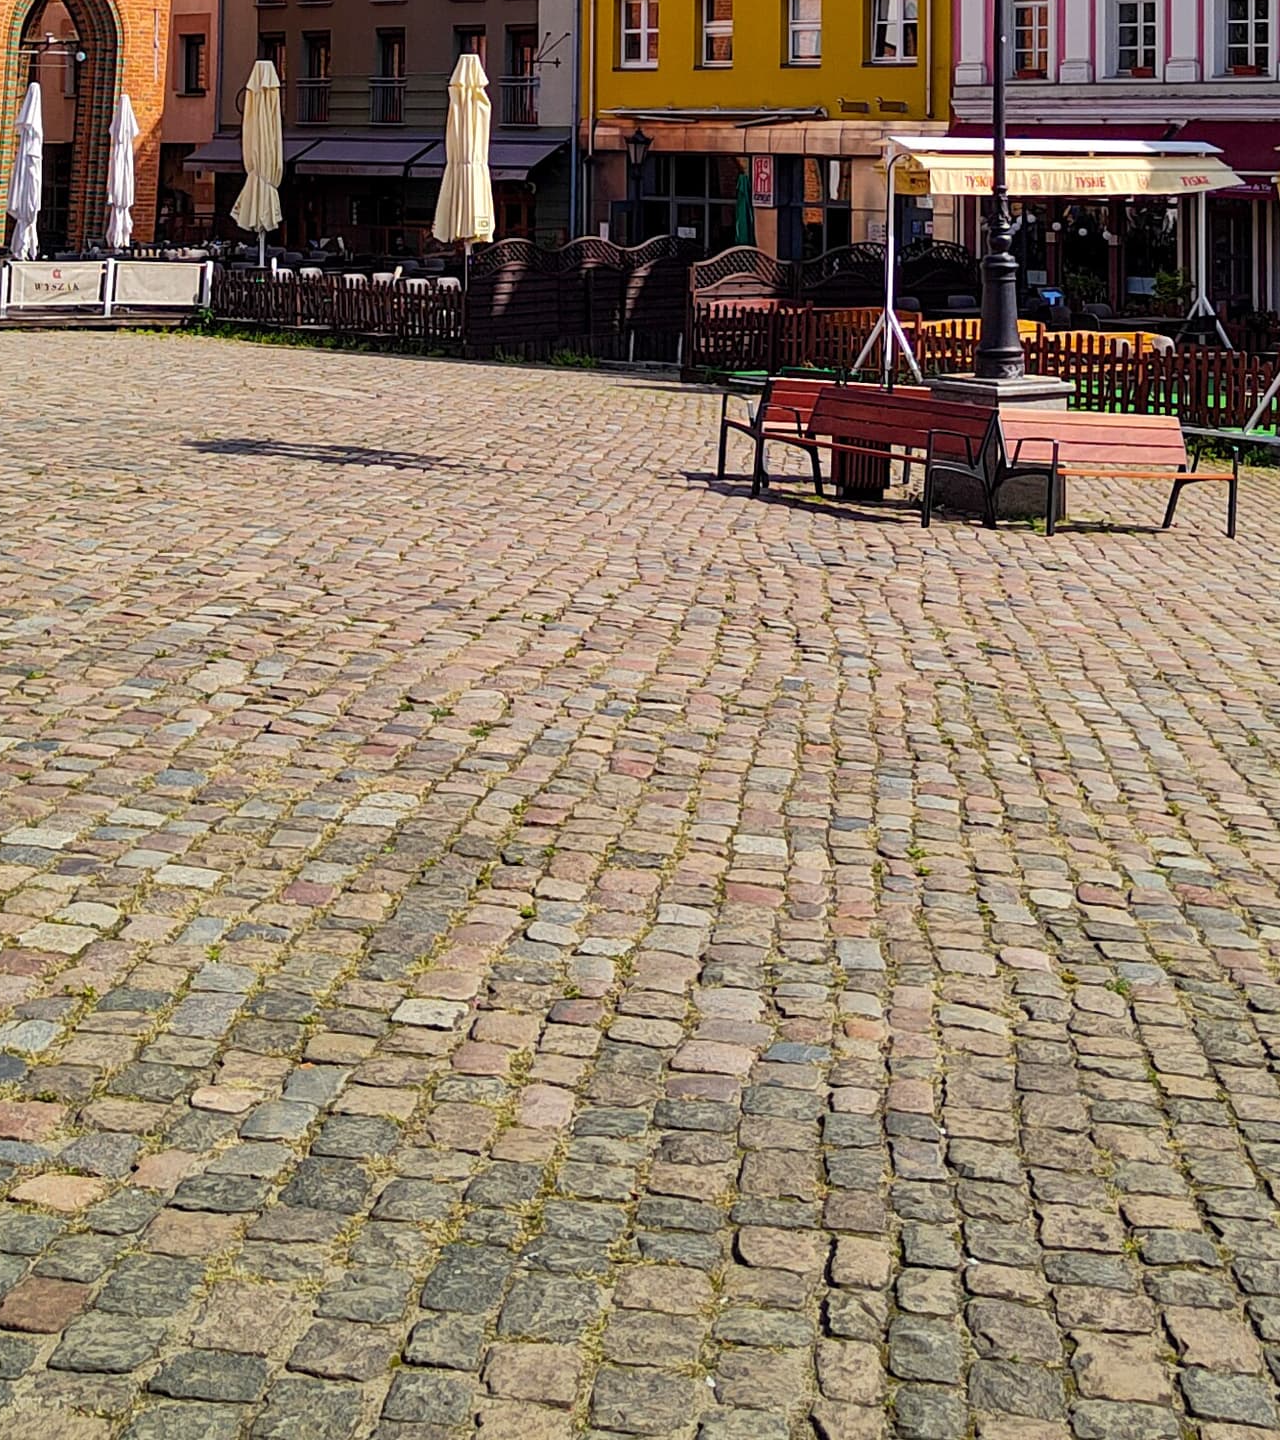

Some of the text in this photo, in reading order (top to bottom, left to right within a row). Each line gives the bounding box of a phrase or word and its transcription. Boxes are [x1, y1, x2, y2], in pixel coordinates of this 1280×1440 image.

[1075, 176, 1106, 188] TYSKIE
[1180, 175, 1210, 186] TYSKIE
[34, 282, 79, 291] WYSZAK
